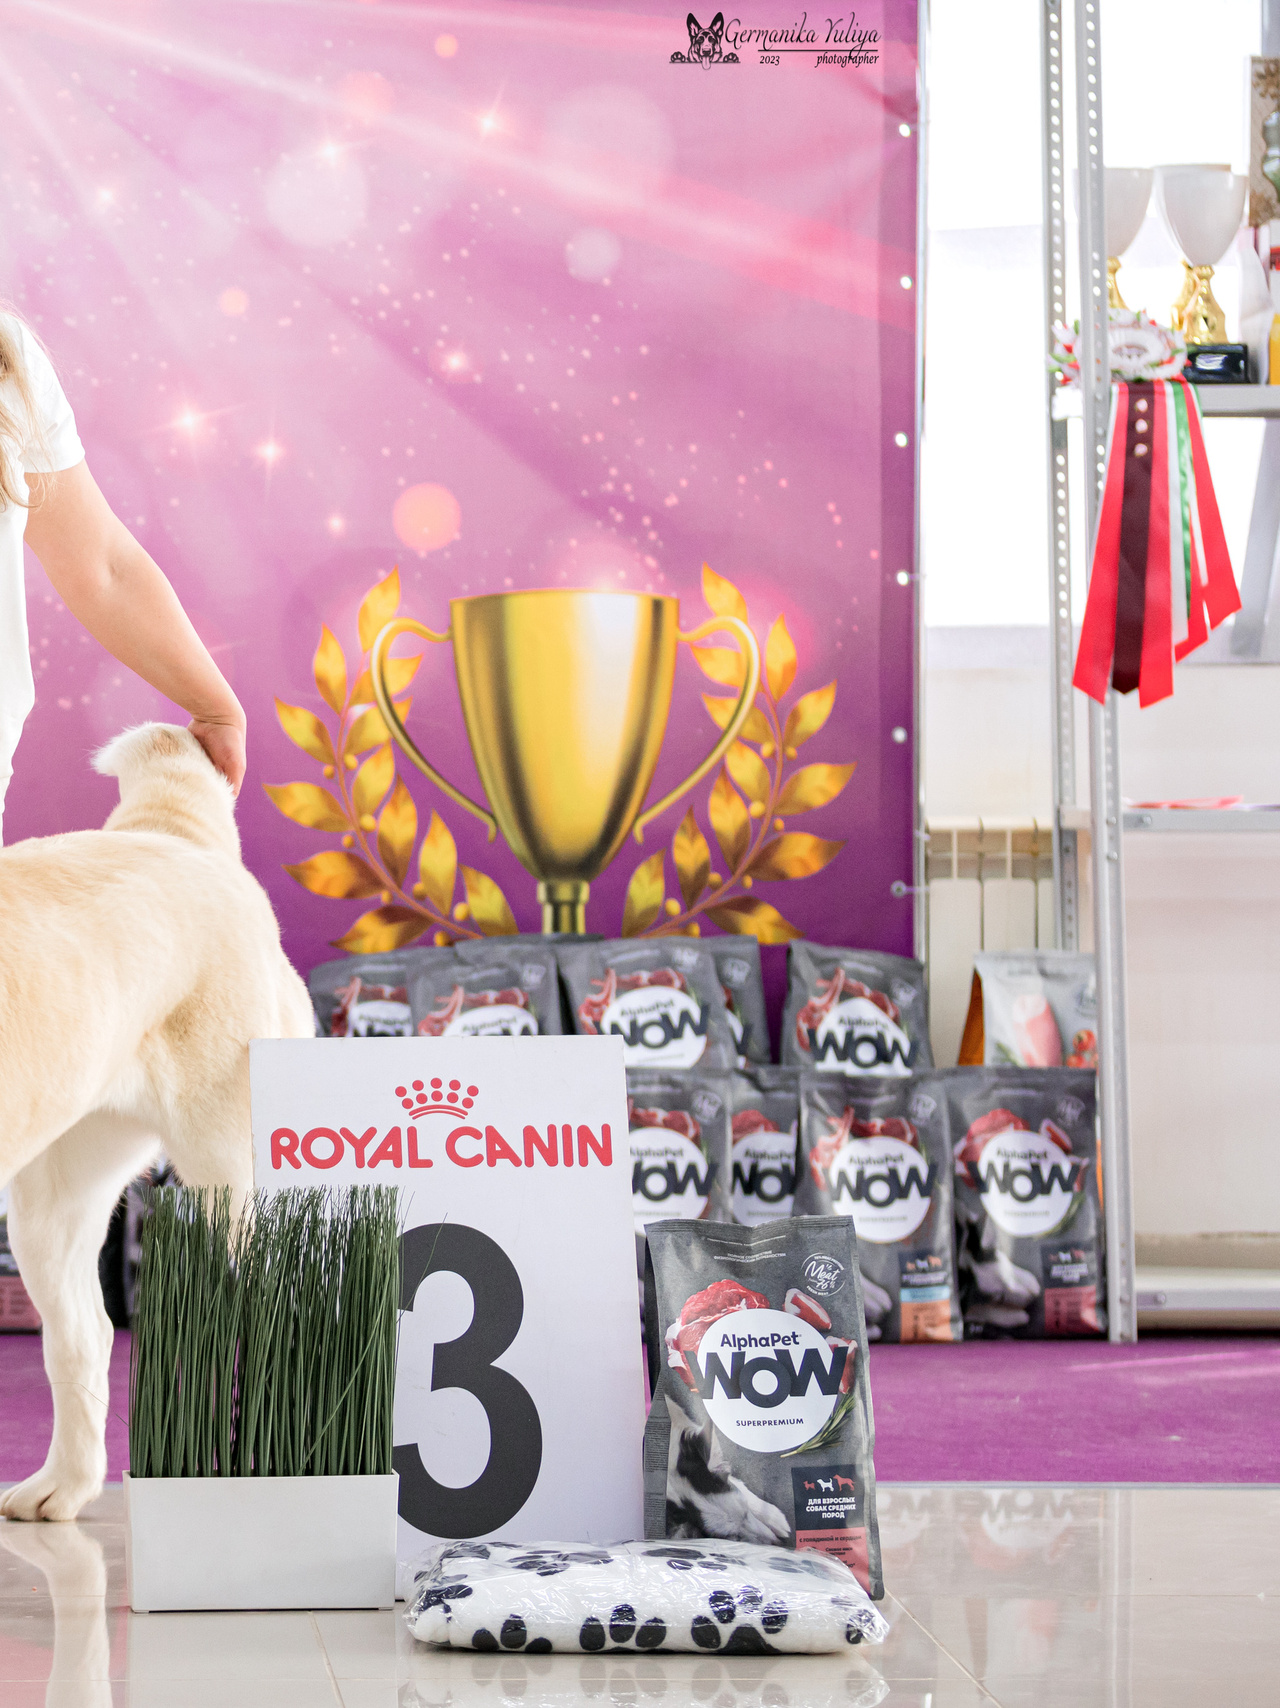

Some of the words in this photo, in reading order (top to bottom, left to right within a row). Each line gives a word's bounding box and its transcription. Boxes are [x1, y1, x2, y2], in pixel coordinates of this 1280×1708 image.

[806, 1028, 919, 1069] WOW
[270, 1125, 433, 1170] ROYAL
[445, 1123, 613, 1168] CANIN
[821, 1161, 939, 1208] WOW
[967, 1160, 1080, 1203] WOW
[804, 1260, 840, 1281] Meat
[720, 1331, 800, 1351] AlphaPet
[394, 1222, 543, 1540] 3
[683, 1346, 849, 1408] WOW
[736, 1418, 804, 1427] SUPERPREMIUM
